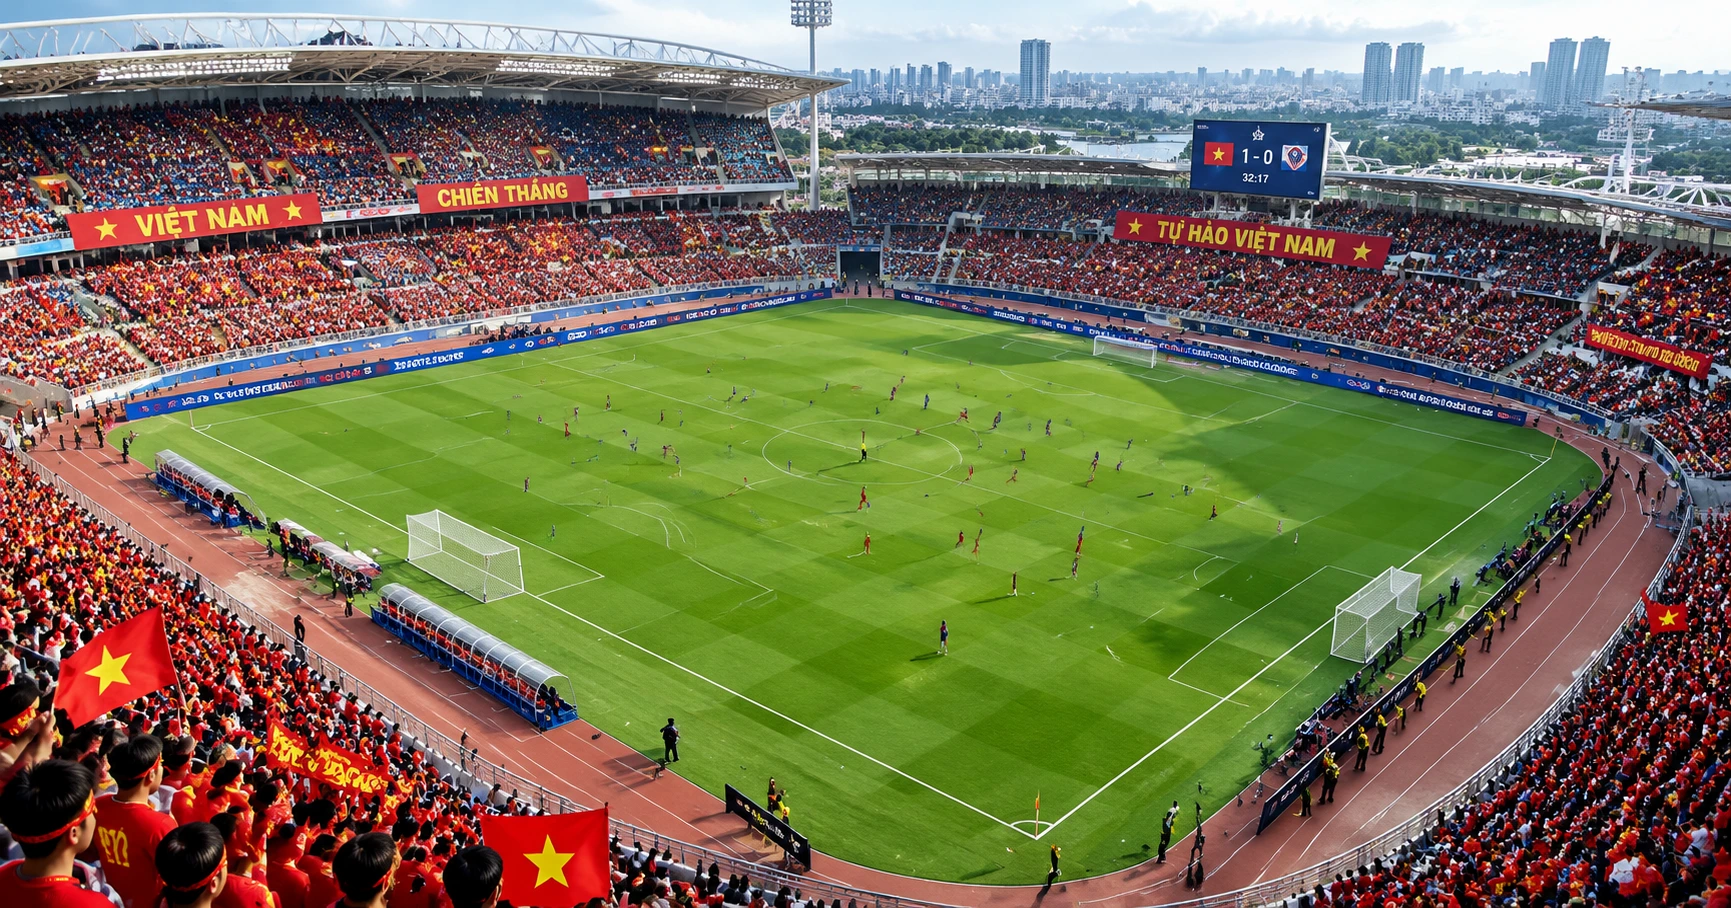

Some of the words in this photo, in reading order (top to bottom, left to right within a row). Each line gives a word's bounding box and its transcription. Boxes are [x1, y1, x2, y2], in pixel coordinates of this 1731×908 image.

[1242, 172, 1269, 184] 32:17
[134, 204, 199, 240] VIỆT
[1235, 225, 1281, 254] VIỆT
[1283, 234, 1336, 259] NAM
